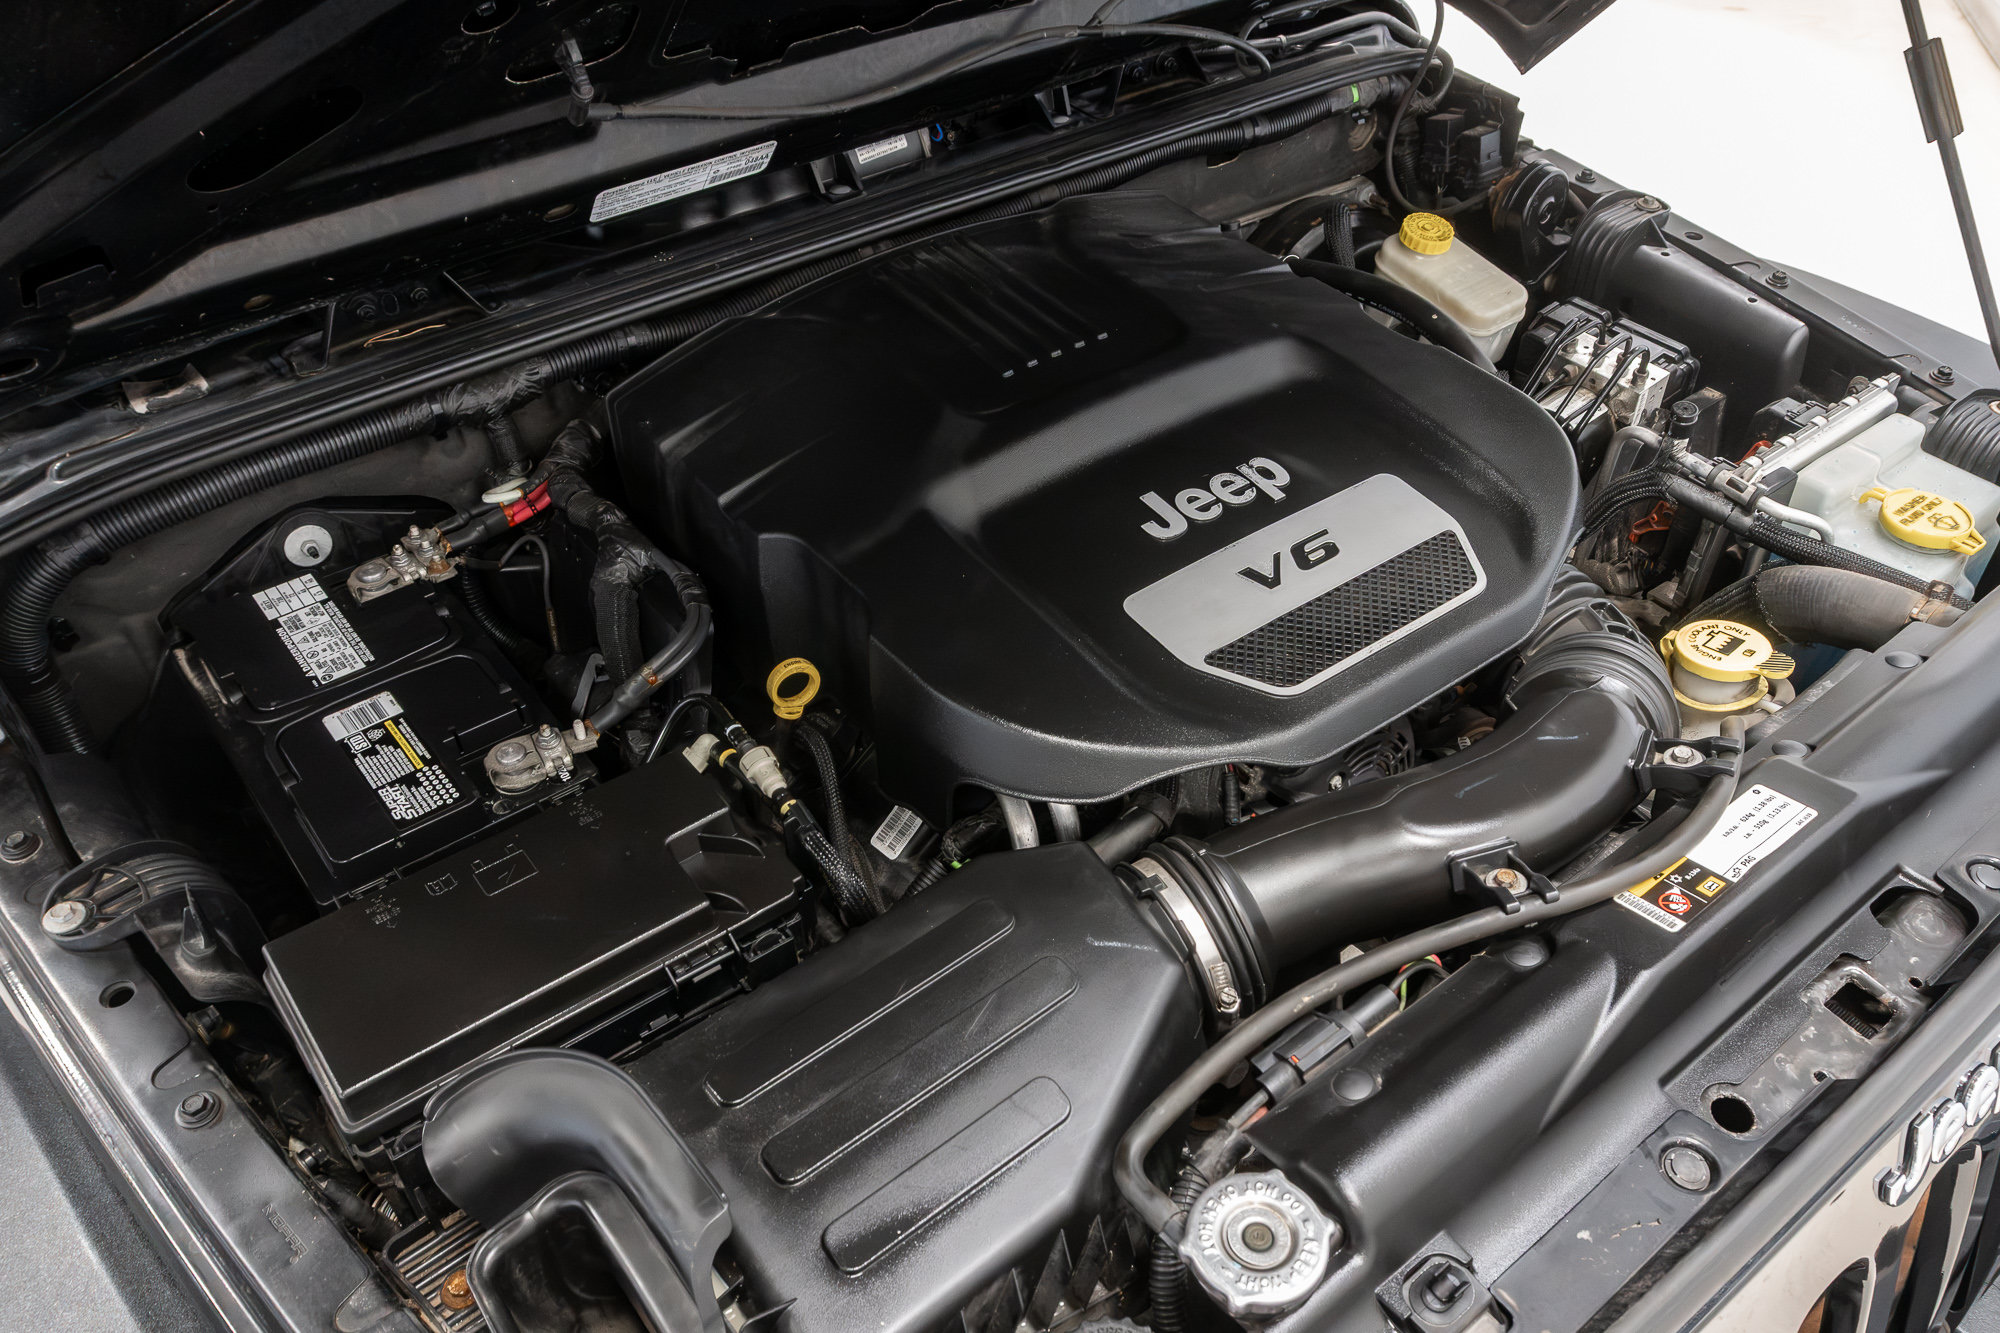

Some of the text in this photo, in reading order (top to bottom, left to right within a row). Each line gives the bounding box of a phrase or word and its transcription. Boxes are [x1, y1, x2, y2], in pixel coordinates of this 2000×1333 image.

[1139, 456, 1291, 542] Jeep
[1237, 527, 1341, 590] V6
[1688, 623, 1752, 662] ENGINE COOLANT ONLY
[349, 734, 367, 751] STD
[378, 787, 405, 820] SUPER
[387, 783, 419, 820] START
[1740, 855, 1757, 868] PAG
[1873, 1036, 2000, 1208] Jee
